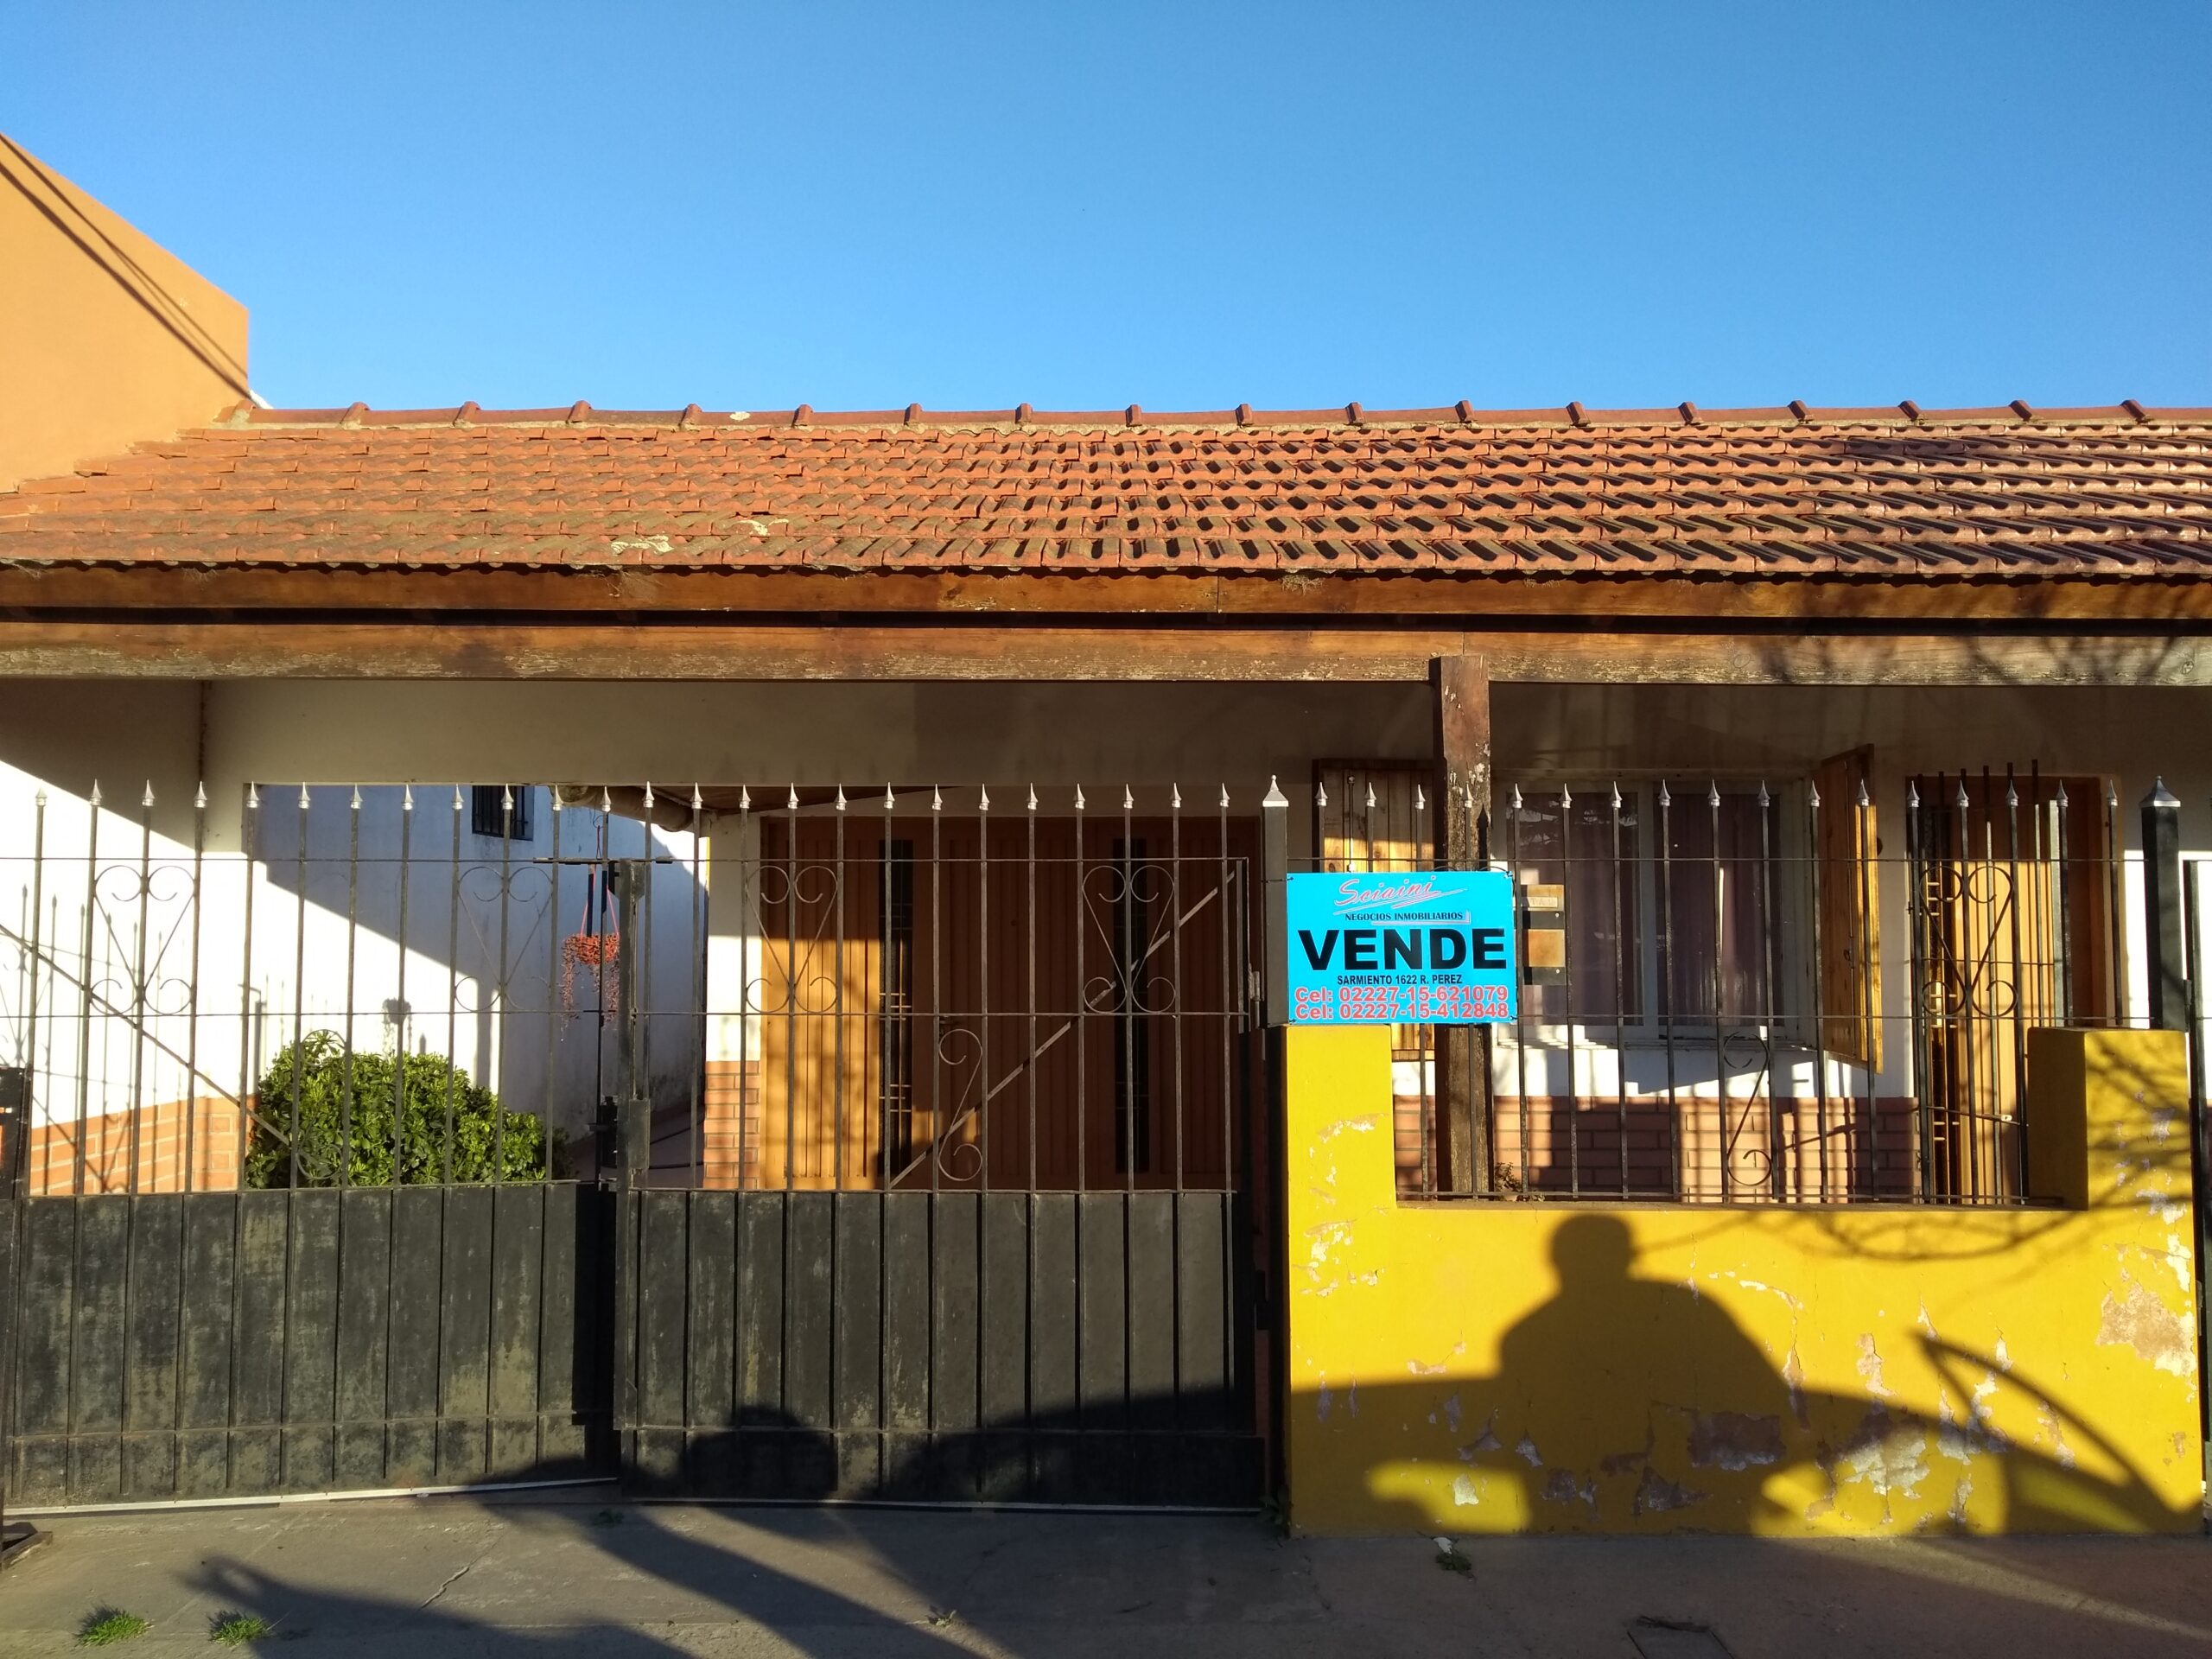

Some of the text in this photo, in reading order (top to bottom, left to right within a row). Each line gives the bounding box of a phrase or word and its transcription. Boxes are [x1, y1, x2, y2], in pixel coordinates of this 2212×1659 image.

[1395, 912, 1463, 920] INMOBILIARIOS
[1298, 929, 1507, 971] VENDE
[1338, 975, 1462, 985] SARMIENTO 1622 R. PEREZ
[1295, 986, 1508, 1002] Cel: 02227-15-621079
[1295, 1002, 1509, 1020] Cel: 02227-15-412848
